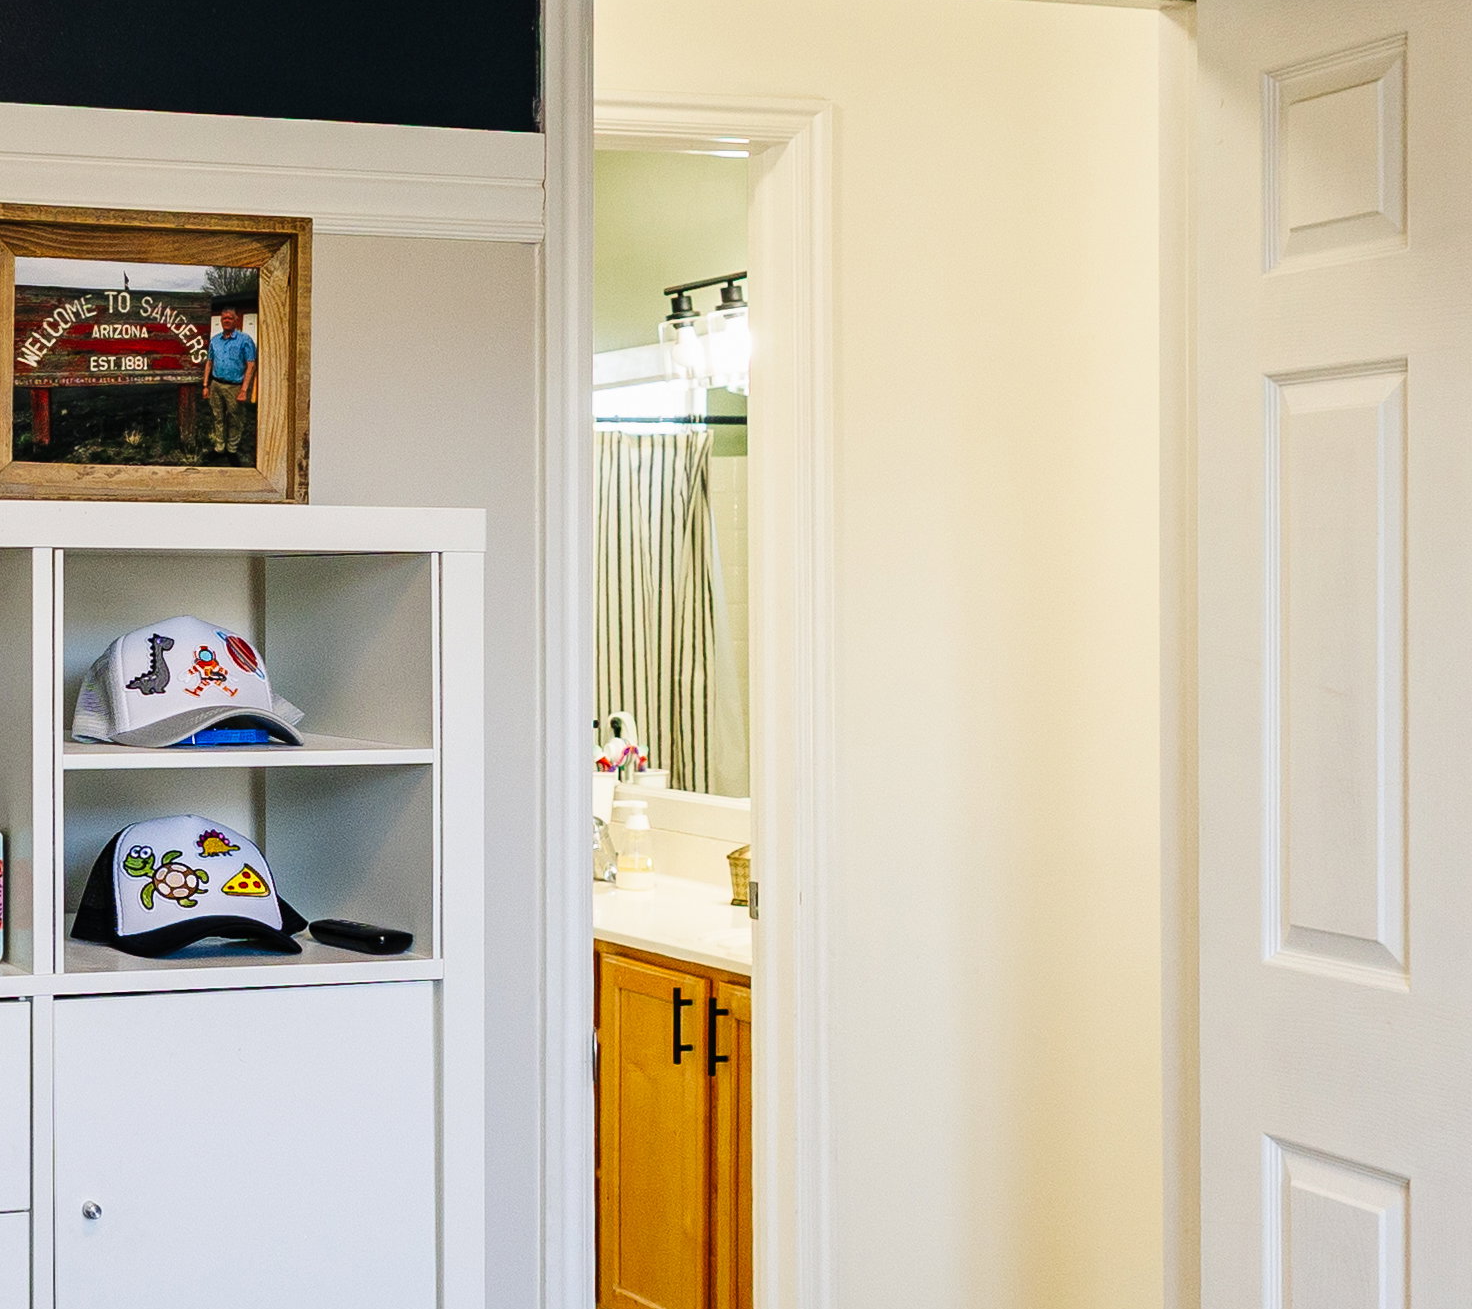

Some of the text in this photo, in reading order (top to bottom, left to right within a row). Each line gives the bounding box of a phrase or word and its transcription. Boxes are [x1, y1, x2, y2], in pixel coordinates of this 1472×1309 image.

[17, 291, 207, 368] WELCOME TO SANDERS
[92, 324, 148, 339] ARIZONA
[90, 356, 147, 371] EST. 1881
